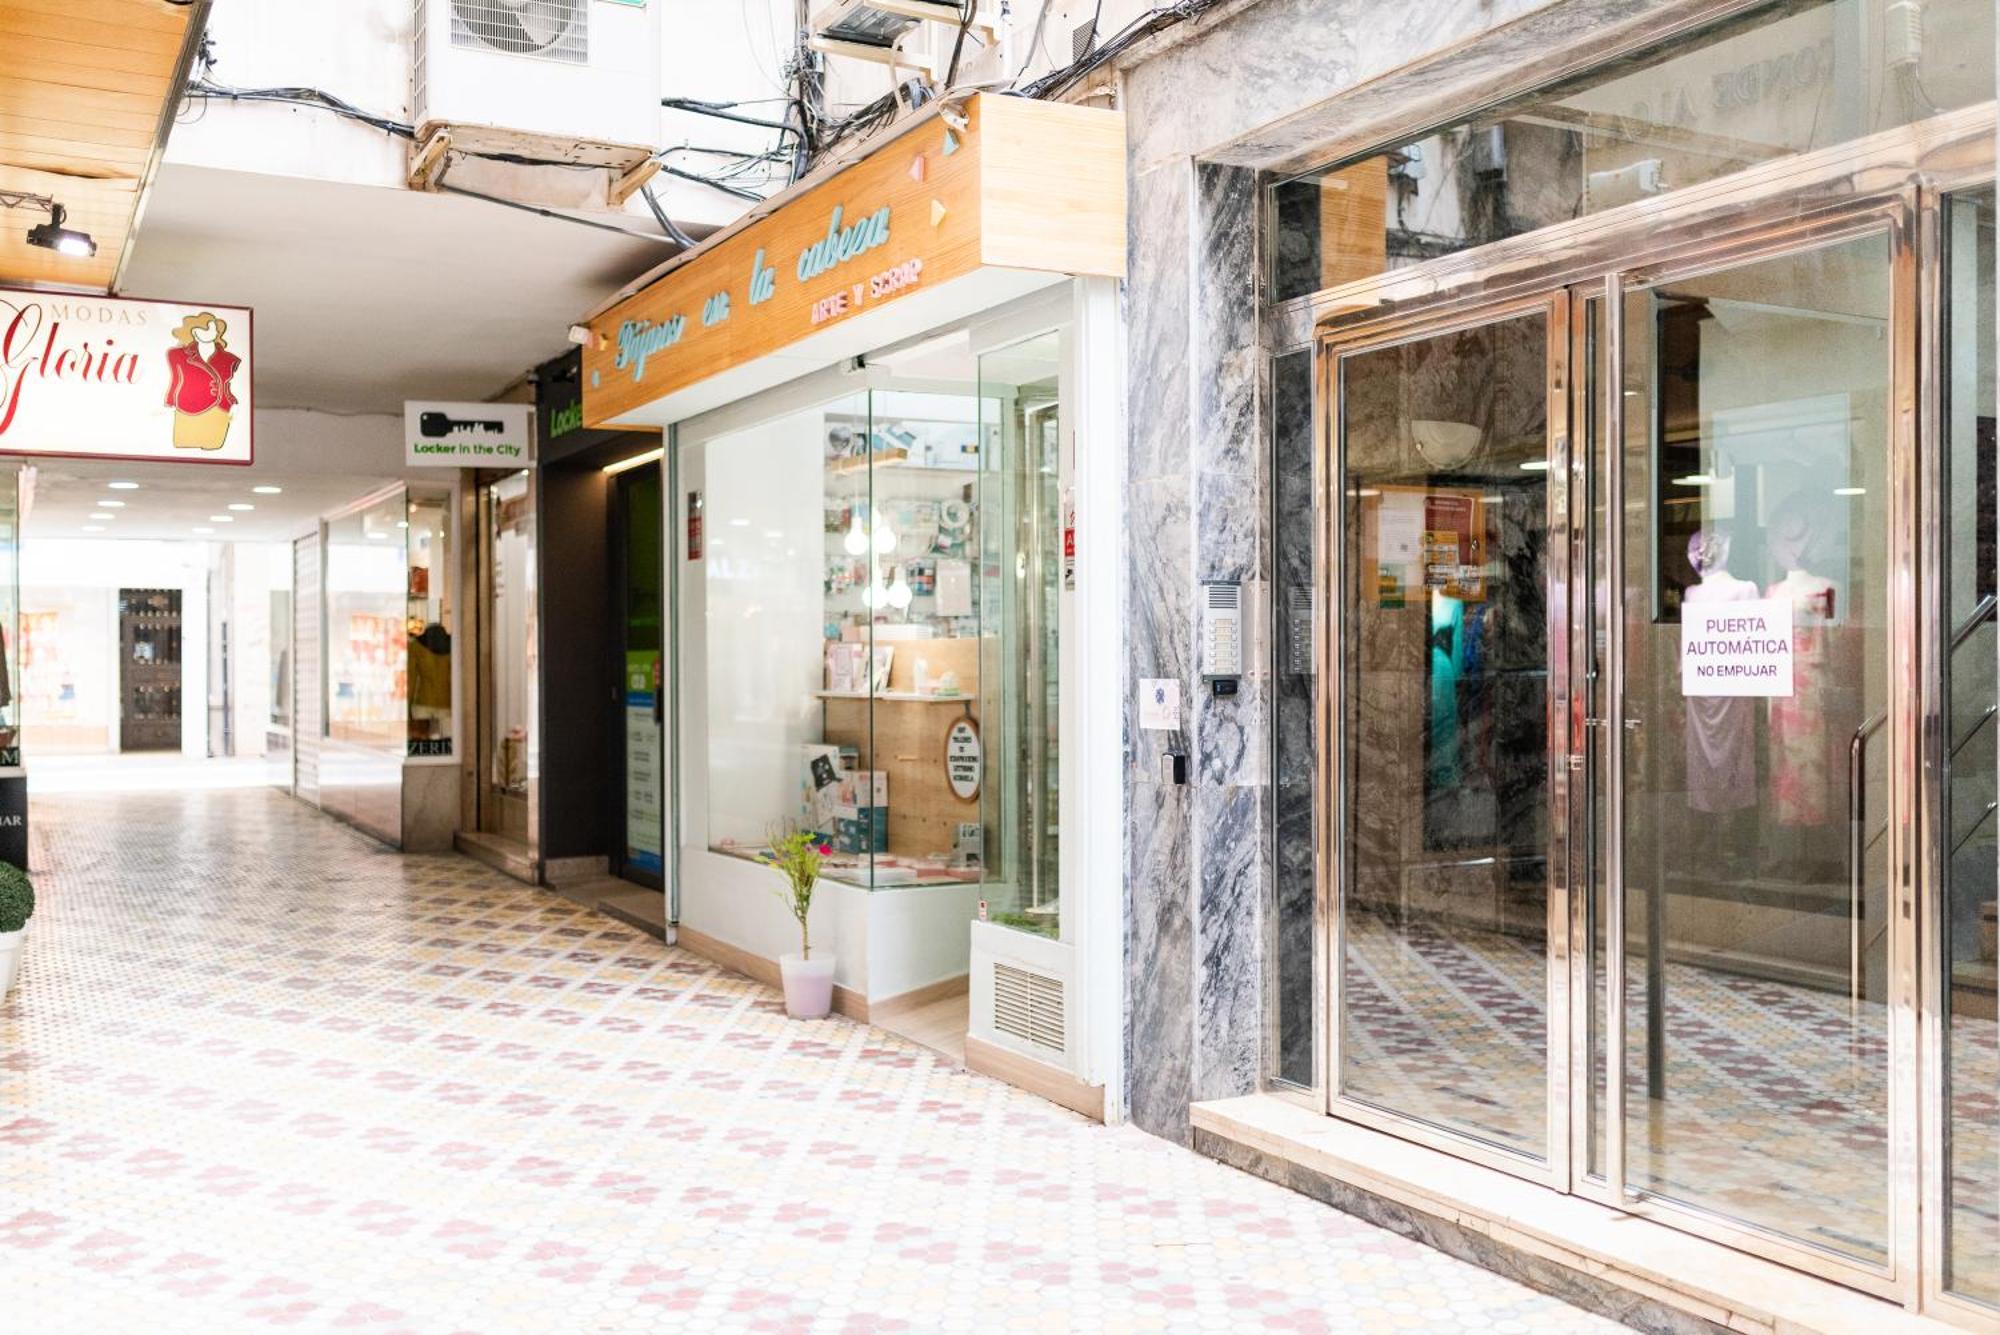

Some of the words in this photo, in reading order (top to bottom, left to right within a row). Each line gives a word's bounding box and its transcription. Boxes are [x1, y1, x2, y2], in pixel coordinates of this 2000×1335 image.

[703, 291, 731, 326] en
[749, 248, 775, 305] la
[811, 291, 849, 325] ARTE
[852, 283, 864, 306] Y
[869, 257, 923, 298] SCRAP
[51, 304, 147, 326] MODAS
[0, 300, 141, 435] Gloria
[414, 443, 456, 454] Locker
[459, 443, 471, 455] in
[473, 444, 494, 455] the
[497, 444, 521, 457] City
[1706, 617, 1766, 633] PUERTA
[1687, 636, 1788, 655] AUTOMÁTICA
[1697, 665, 1714, 676] NO
[1717, 665, 1777, 676] EMPUJAR
